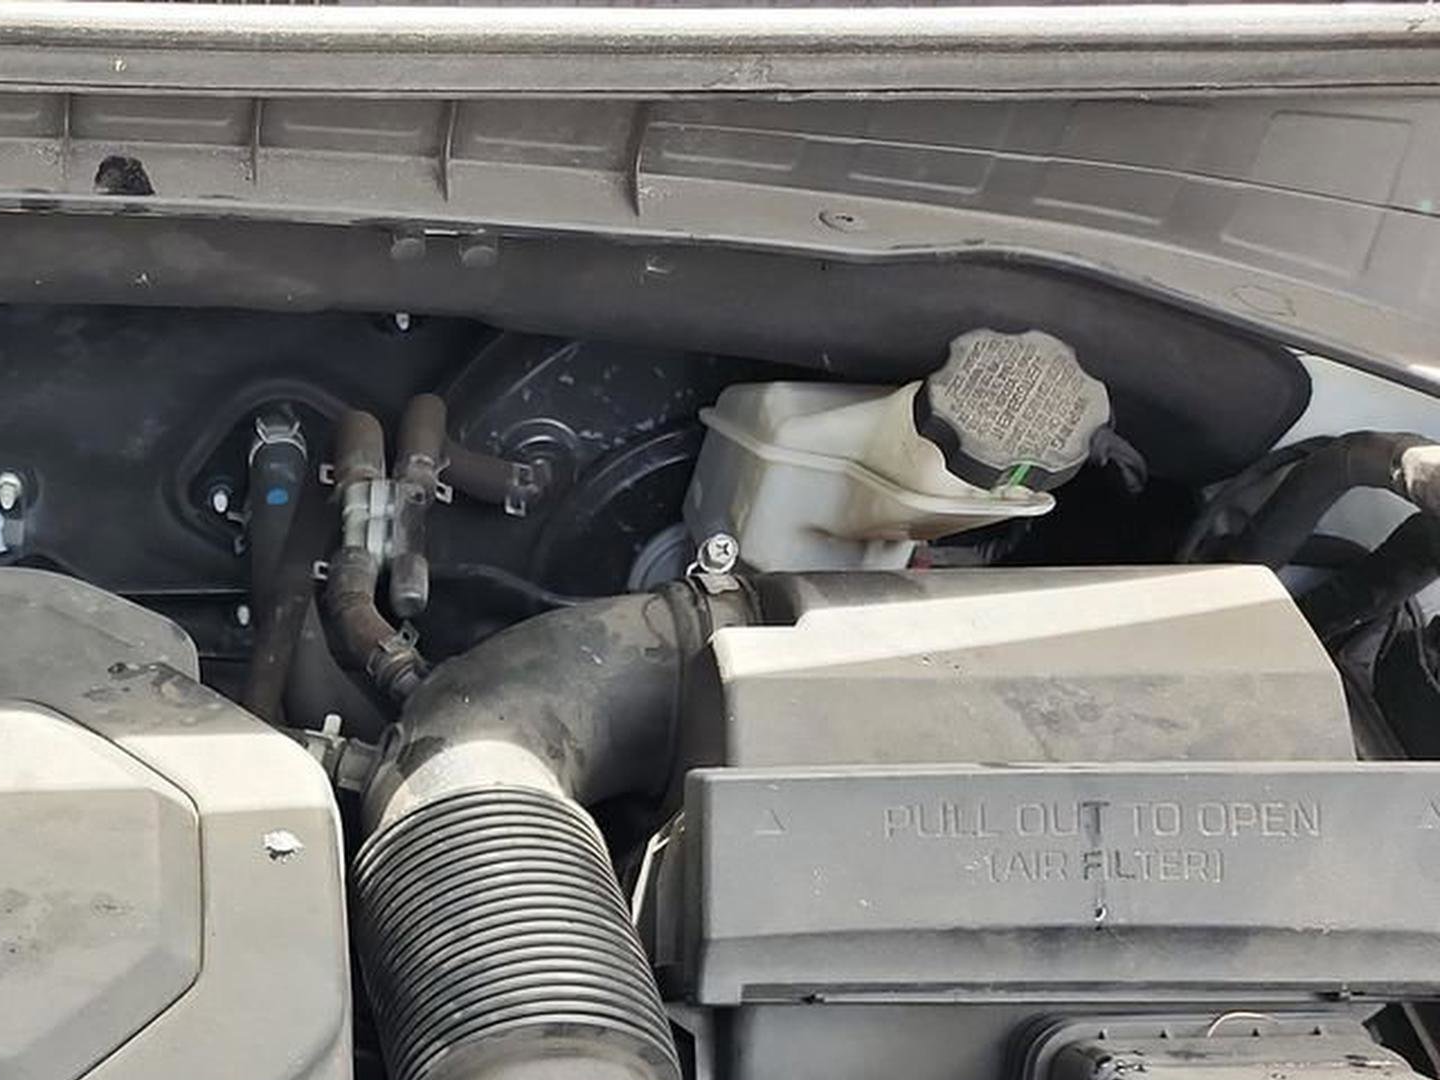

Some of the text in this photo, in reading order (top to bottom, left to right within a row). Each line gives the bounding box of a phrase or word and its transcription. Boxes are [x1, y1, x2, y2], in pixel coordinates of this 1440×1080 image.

[884, 801, 1321, 838] PULL OUT TO OPEN
